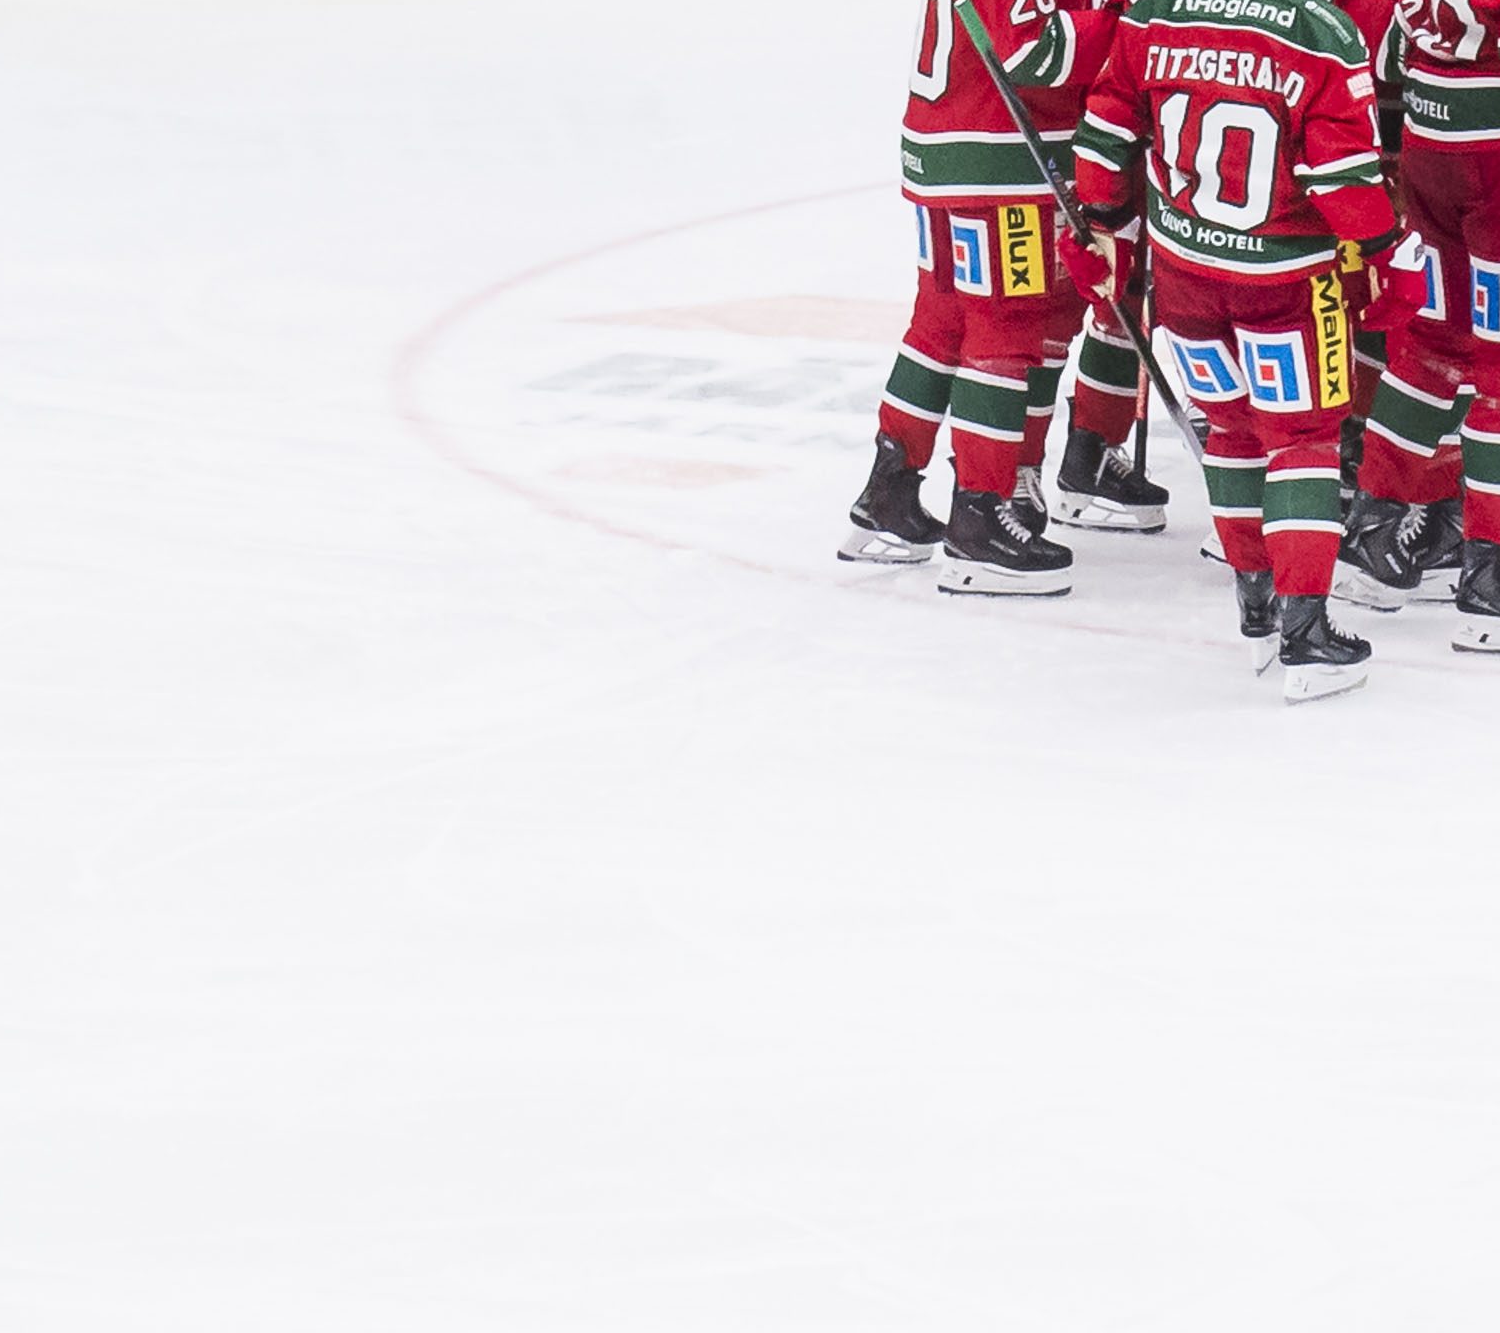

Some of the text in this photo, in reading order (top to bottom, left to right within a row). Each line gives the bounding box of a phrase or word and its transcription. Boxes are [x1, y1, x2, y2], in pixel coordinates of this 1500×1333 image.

[1159, 92, 1281, 232] 10
[1160, 211, 1264, 253] ULVÖ HOTELL
[1312, 274, 1344, 401] Malux
